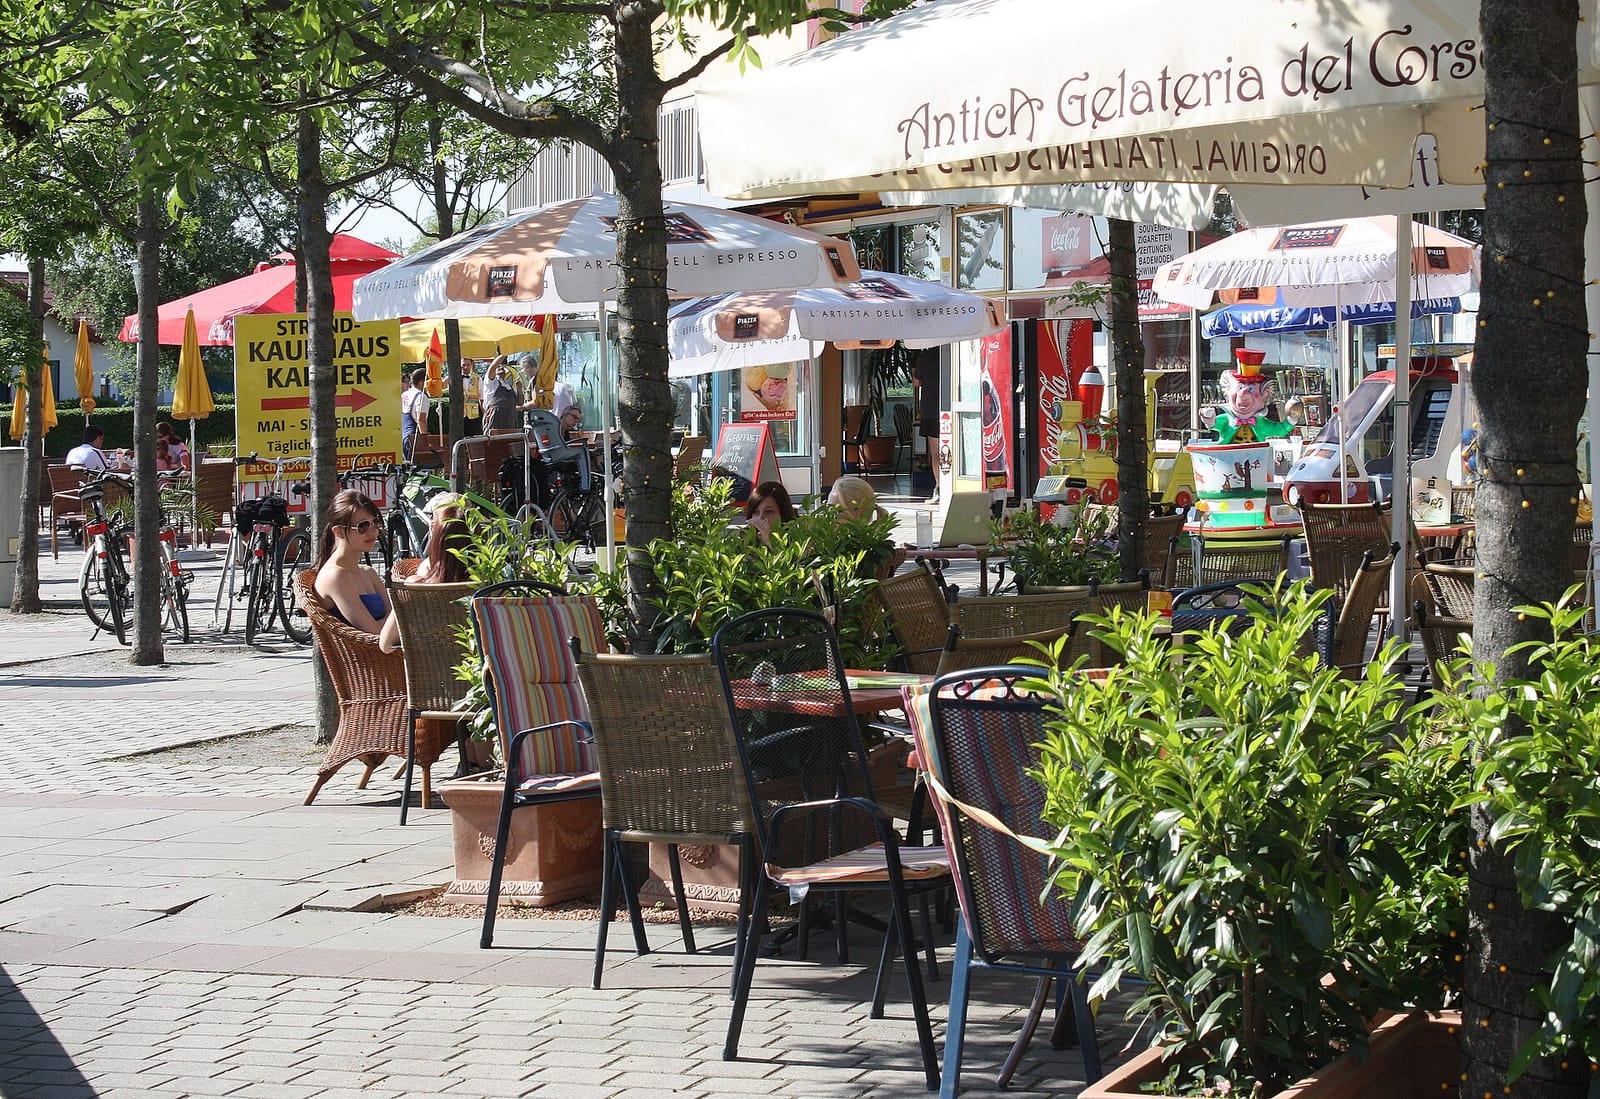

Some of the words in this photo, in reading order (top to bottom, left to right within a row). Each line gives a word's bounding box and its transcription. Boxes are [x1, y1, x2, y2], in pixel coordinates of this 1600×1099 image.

[1056, 55, 1265, 130] Gelateria
[1280, 37, 1353, 101] del
[1367, 24, 1486, 88] Cors
[1140, 244, 1172, 254] ZEITUNGEN
[673, 256, 707, 267] ELL'
[717, 250, 798, 265] ESPRESSO
[1325, 253, 1388, 264] ESPRESSO
[490, 270, 515, 279] PIAZZA
[737, 316, 757, 325] PIAZZA
[810, 308, 870, 318] L'ARTISTA
[917, 305, 976, 317] ESPRESSO
[1241, 306, 1294, 326] NIVEA
[277, 317, 361, 336] STRND-
[249, 336, 391, 363] KAUAUS
[267, 364, 374, 388] KAER
[257, 419, 285, 433] MAI
[300, 415, 383, 431] SEMBER
[267, 439, 310, 454] Täglich
[336, 435, 374, 449] ffnet!
